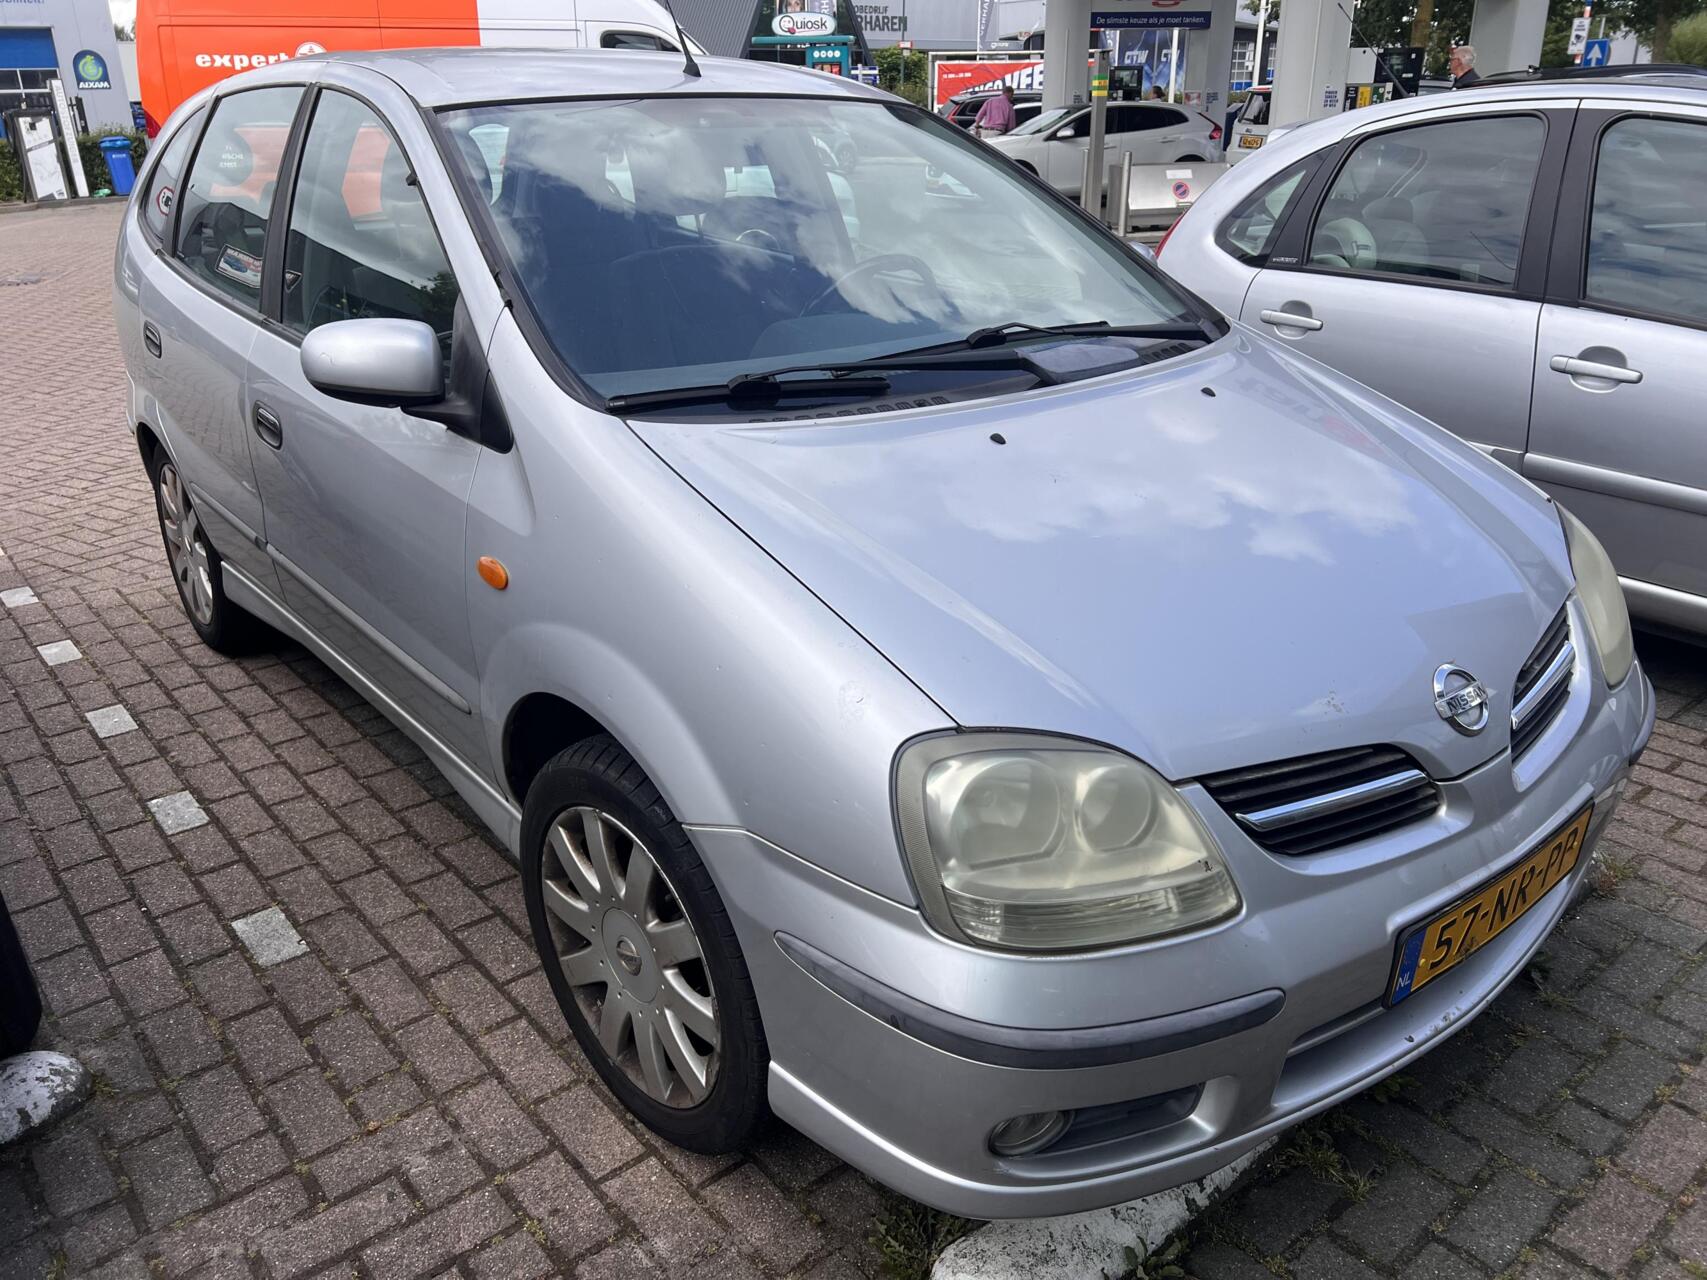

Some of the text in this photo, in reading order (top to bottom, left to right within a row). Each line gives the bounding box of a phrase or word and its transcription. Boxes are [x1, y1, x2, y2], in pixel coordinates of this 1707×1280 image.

[854, 5, 889, 15] OBEDRIJF
[779, 15, 828, 34] Quiosk
[858, 15, 907, 32] RHAREN
[1158, 17, 1165, 25] je
[1166, 16, 1182, 24] moet
[195, 52, 289, 70] expert
[79, 81, 110, 89] AIXAM
[1446, 686, 1486, 714] NISSAN
[1397, 972, 1410, 991] NL
